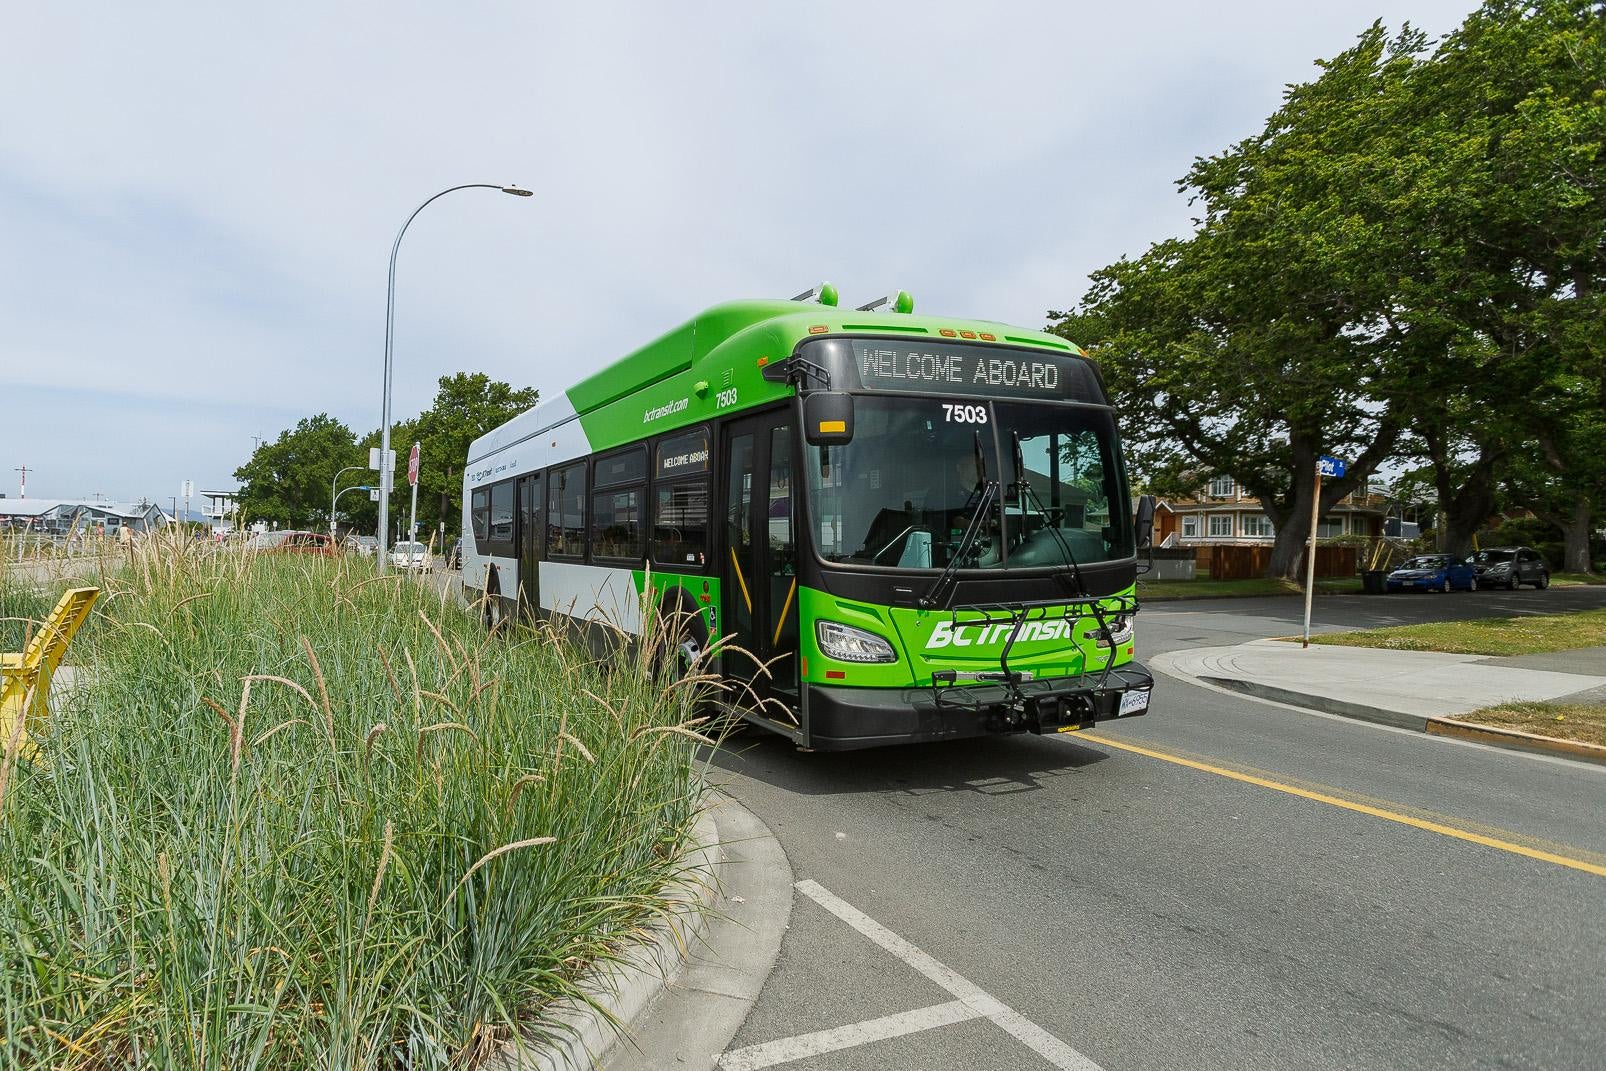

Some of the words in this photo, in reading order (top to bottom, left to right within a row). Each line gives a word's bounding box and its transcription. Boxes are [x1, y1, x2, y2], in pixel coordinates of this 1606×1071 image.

[863, 349, 963, 382] WELCOME
[973, 358, 1058, 389] ABOARD
[715, 387, 738, 409] 7503
[643, 398, 689, 424] bctransit.com
[942, 404, 988, 424] 7503
[409, 457, 418, 473] STOP
[663, 454, 689, 469] WELCOME
[1319, 459, 1335, 473] Pilot
